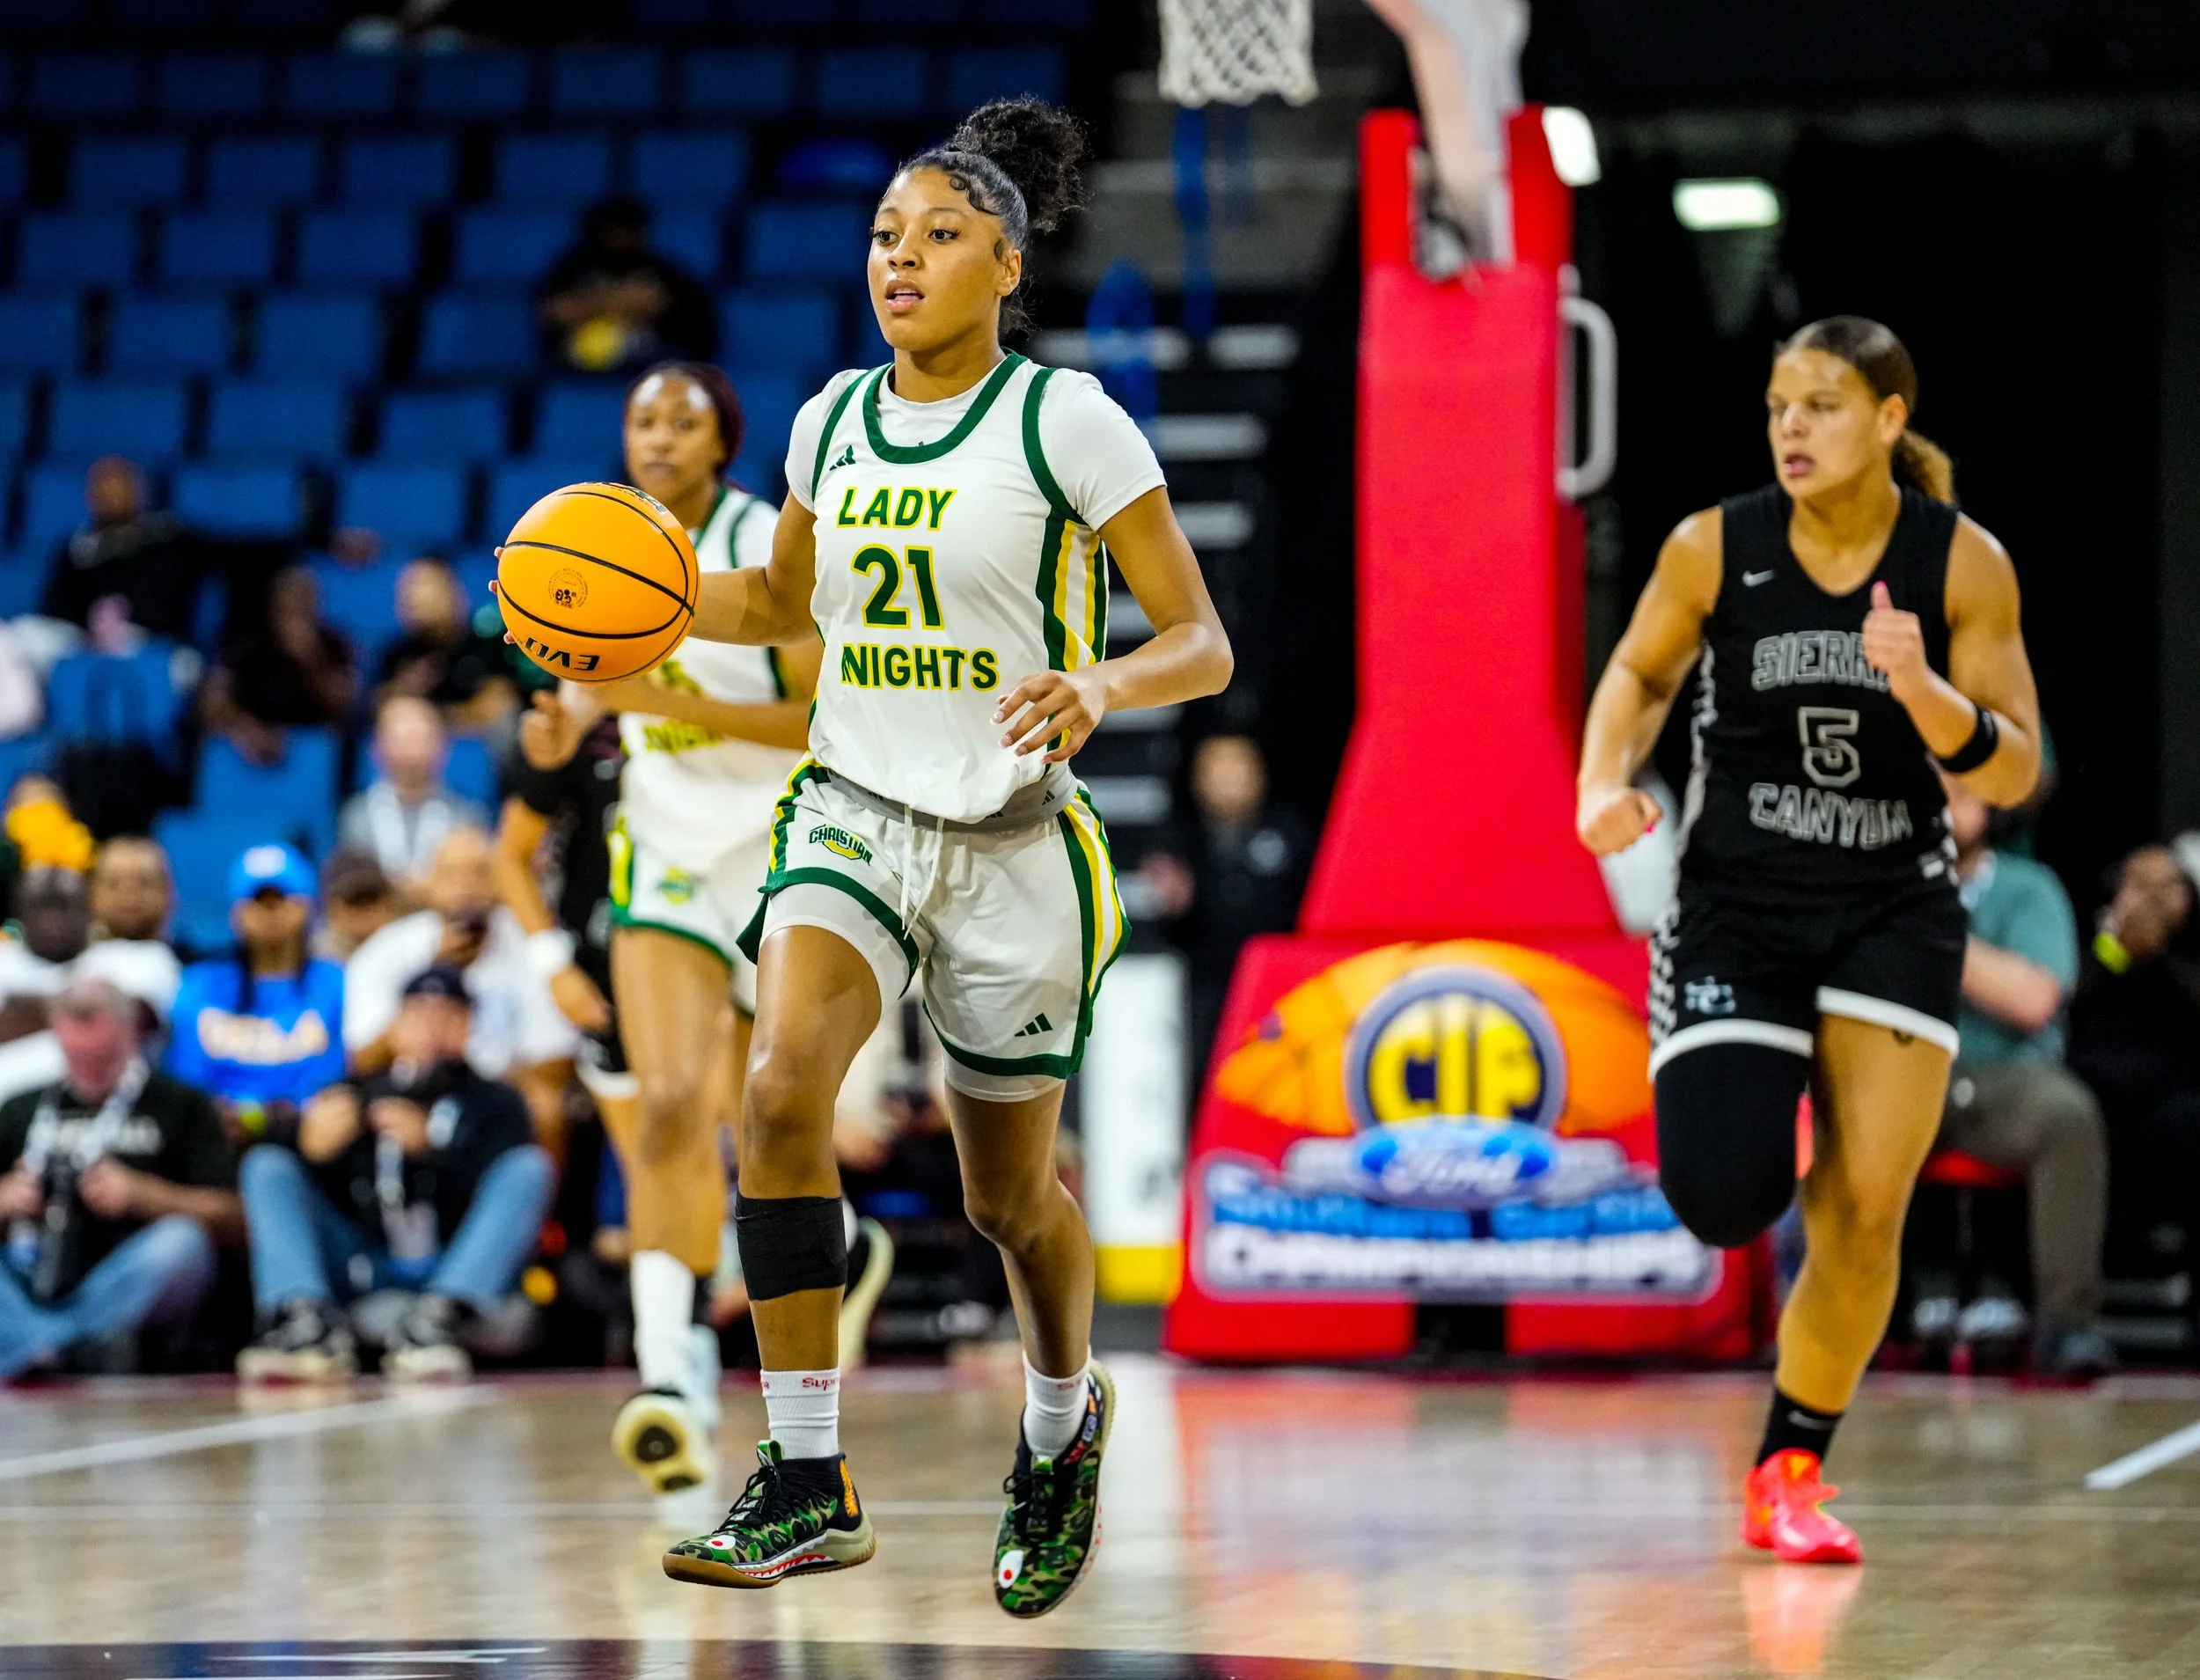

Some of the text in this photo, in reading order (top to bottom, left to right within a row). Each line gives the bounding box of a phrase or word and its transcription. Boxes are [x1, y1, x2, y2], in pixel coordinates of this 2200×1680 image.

[837, 487, 957, 531] LADY
[850, 543, 944, 630] 21
[1797, 706, 1860, 788] 5
[809, 824, 873, 867] CHRISTIAN
[1748, 782, 1913, 851] CANYON
